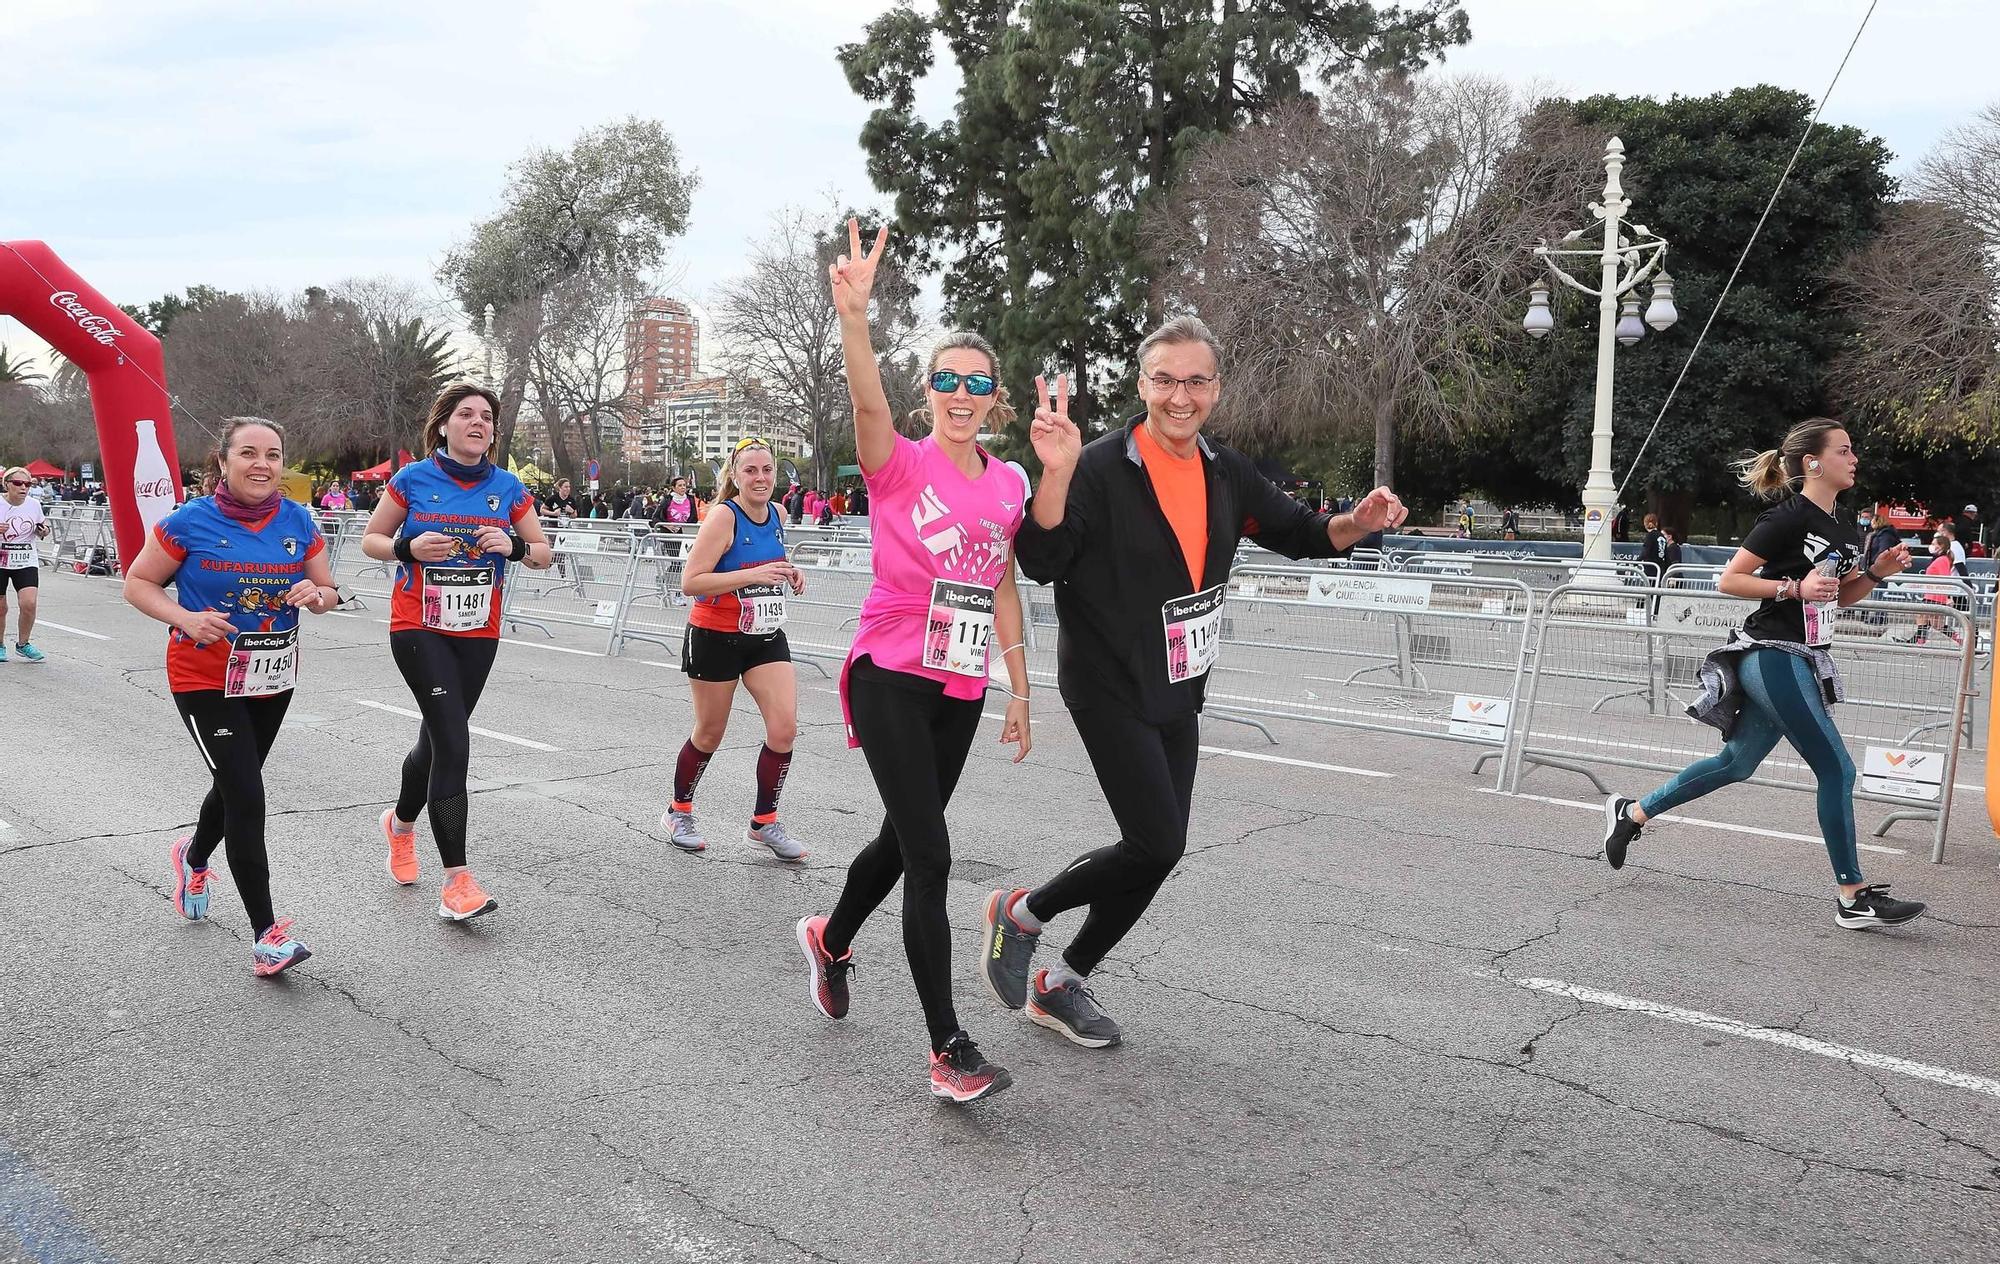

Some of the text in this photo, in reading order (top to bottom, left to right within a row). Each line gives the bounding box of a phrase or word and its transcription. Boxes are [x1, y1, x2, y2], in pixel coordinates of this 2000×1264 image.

[136, 477, 173, 498] oca-Cola
[414, 511, 510, 528] XUFARUNNERS
[979, 518, 1004, 533] THERE'S
[239, 577, 291, 585] ALBORAYA
[433, 573, 471, 583] iberCaja
[446, 593, 485, 610] 11481
[1173, 600, 1211, 616] iberCaja
[757, 602, 783, 616] 11439
[430, 615, 440, 623] 05
[930, 619, 953, 632] 10K
[244, 638, 284, 647] iberCaja
[1168, 635, 1186, 650] 10K
[933, 648, 947, 661] 05
[254, 652, 292, 673] 11450
[1176, 661, 1187, 674] 05
[232, 681, 244, 690] 05
